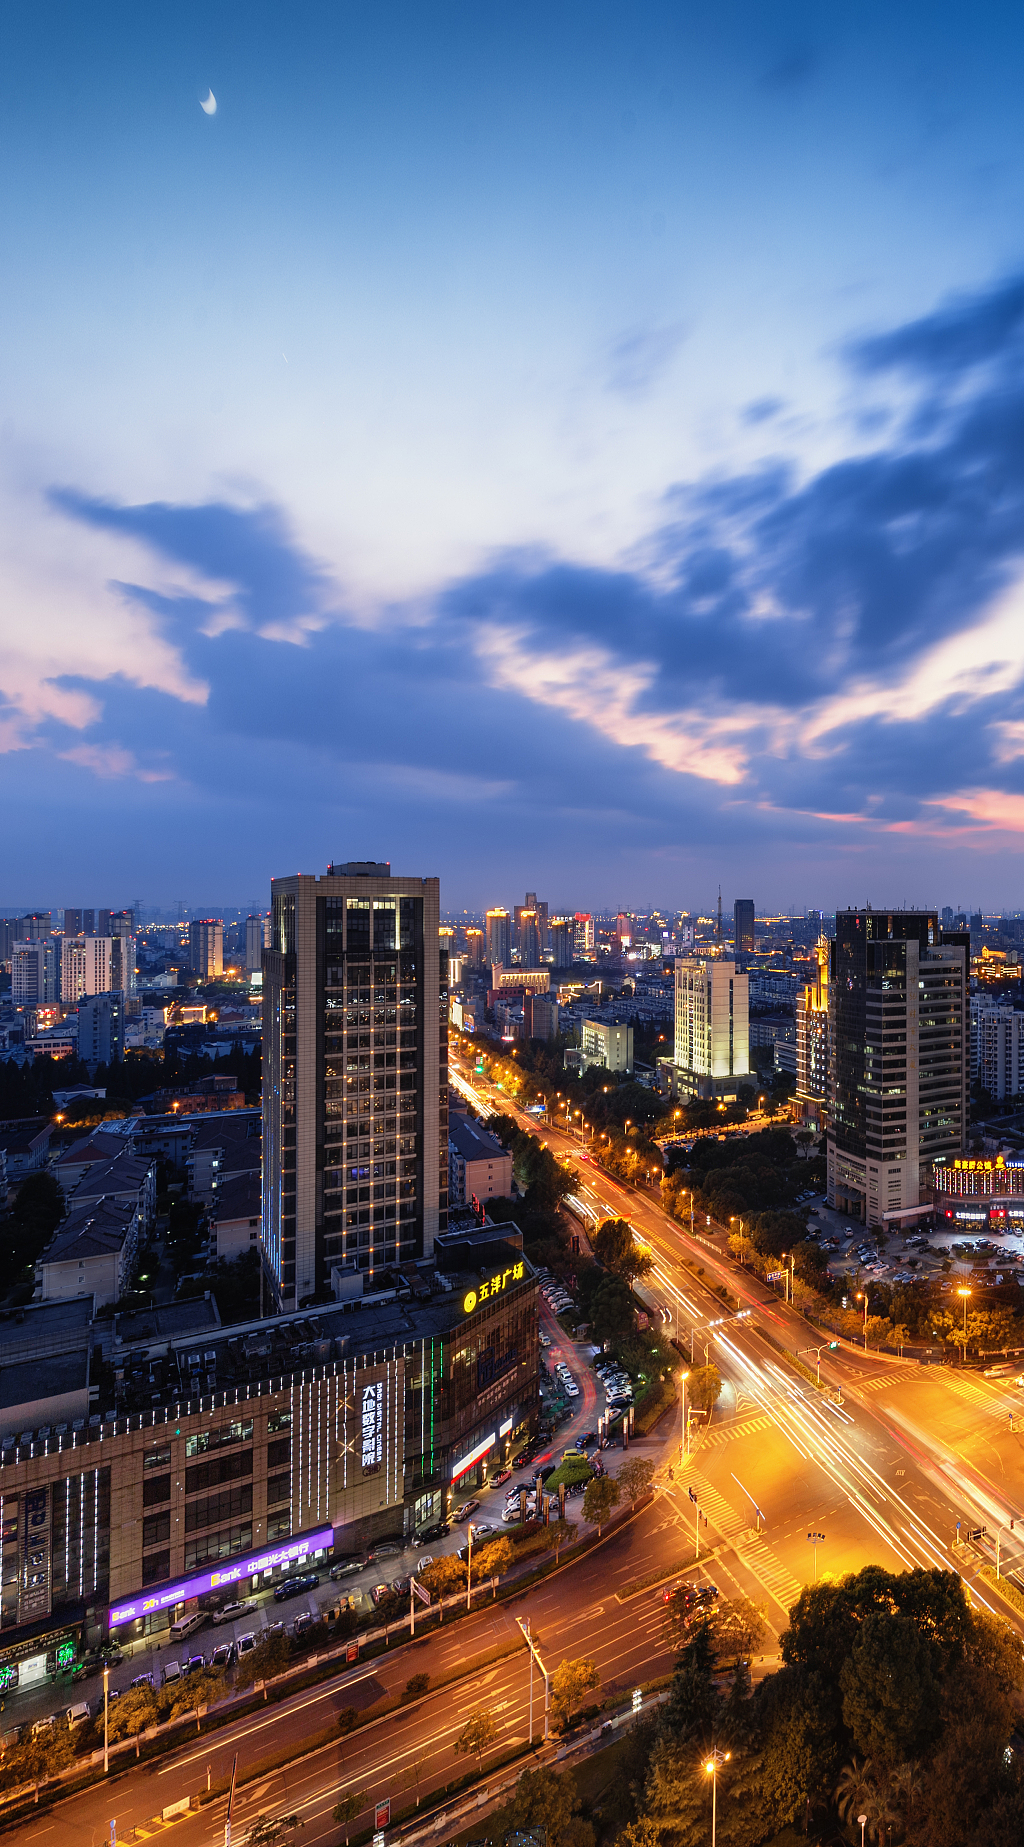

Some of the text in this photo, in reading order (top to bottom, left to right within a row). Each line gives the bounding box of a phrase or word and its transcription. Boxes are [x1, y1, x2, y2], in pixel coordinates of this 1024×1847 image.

[478, 1261, 524, 1303] 五洋广场
[361, 1385, 376, 1467] 大地数字影院
[247, 1542, 310, 1573] 中国光大银行
[210, 1567, 242, 1587] Bank
[112, 1607, 136, 1622] Bank
